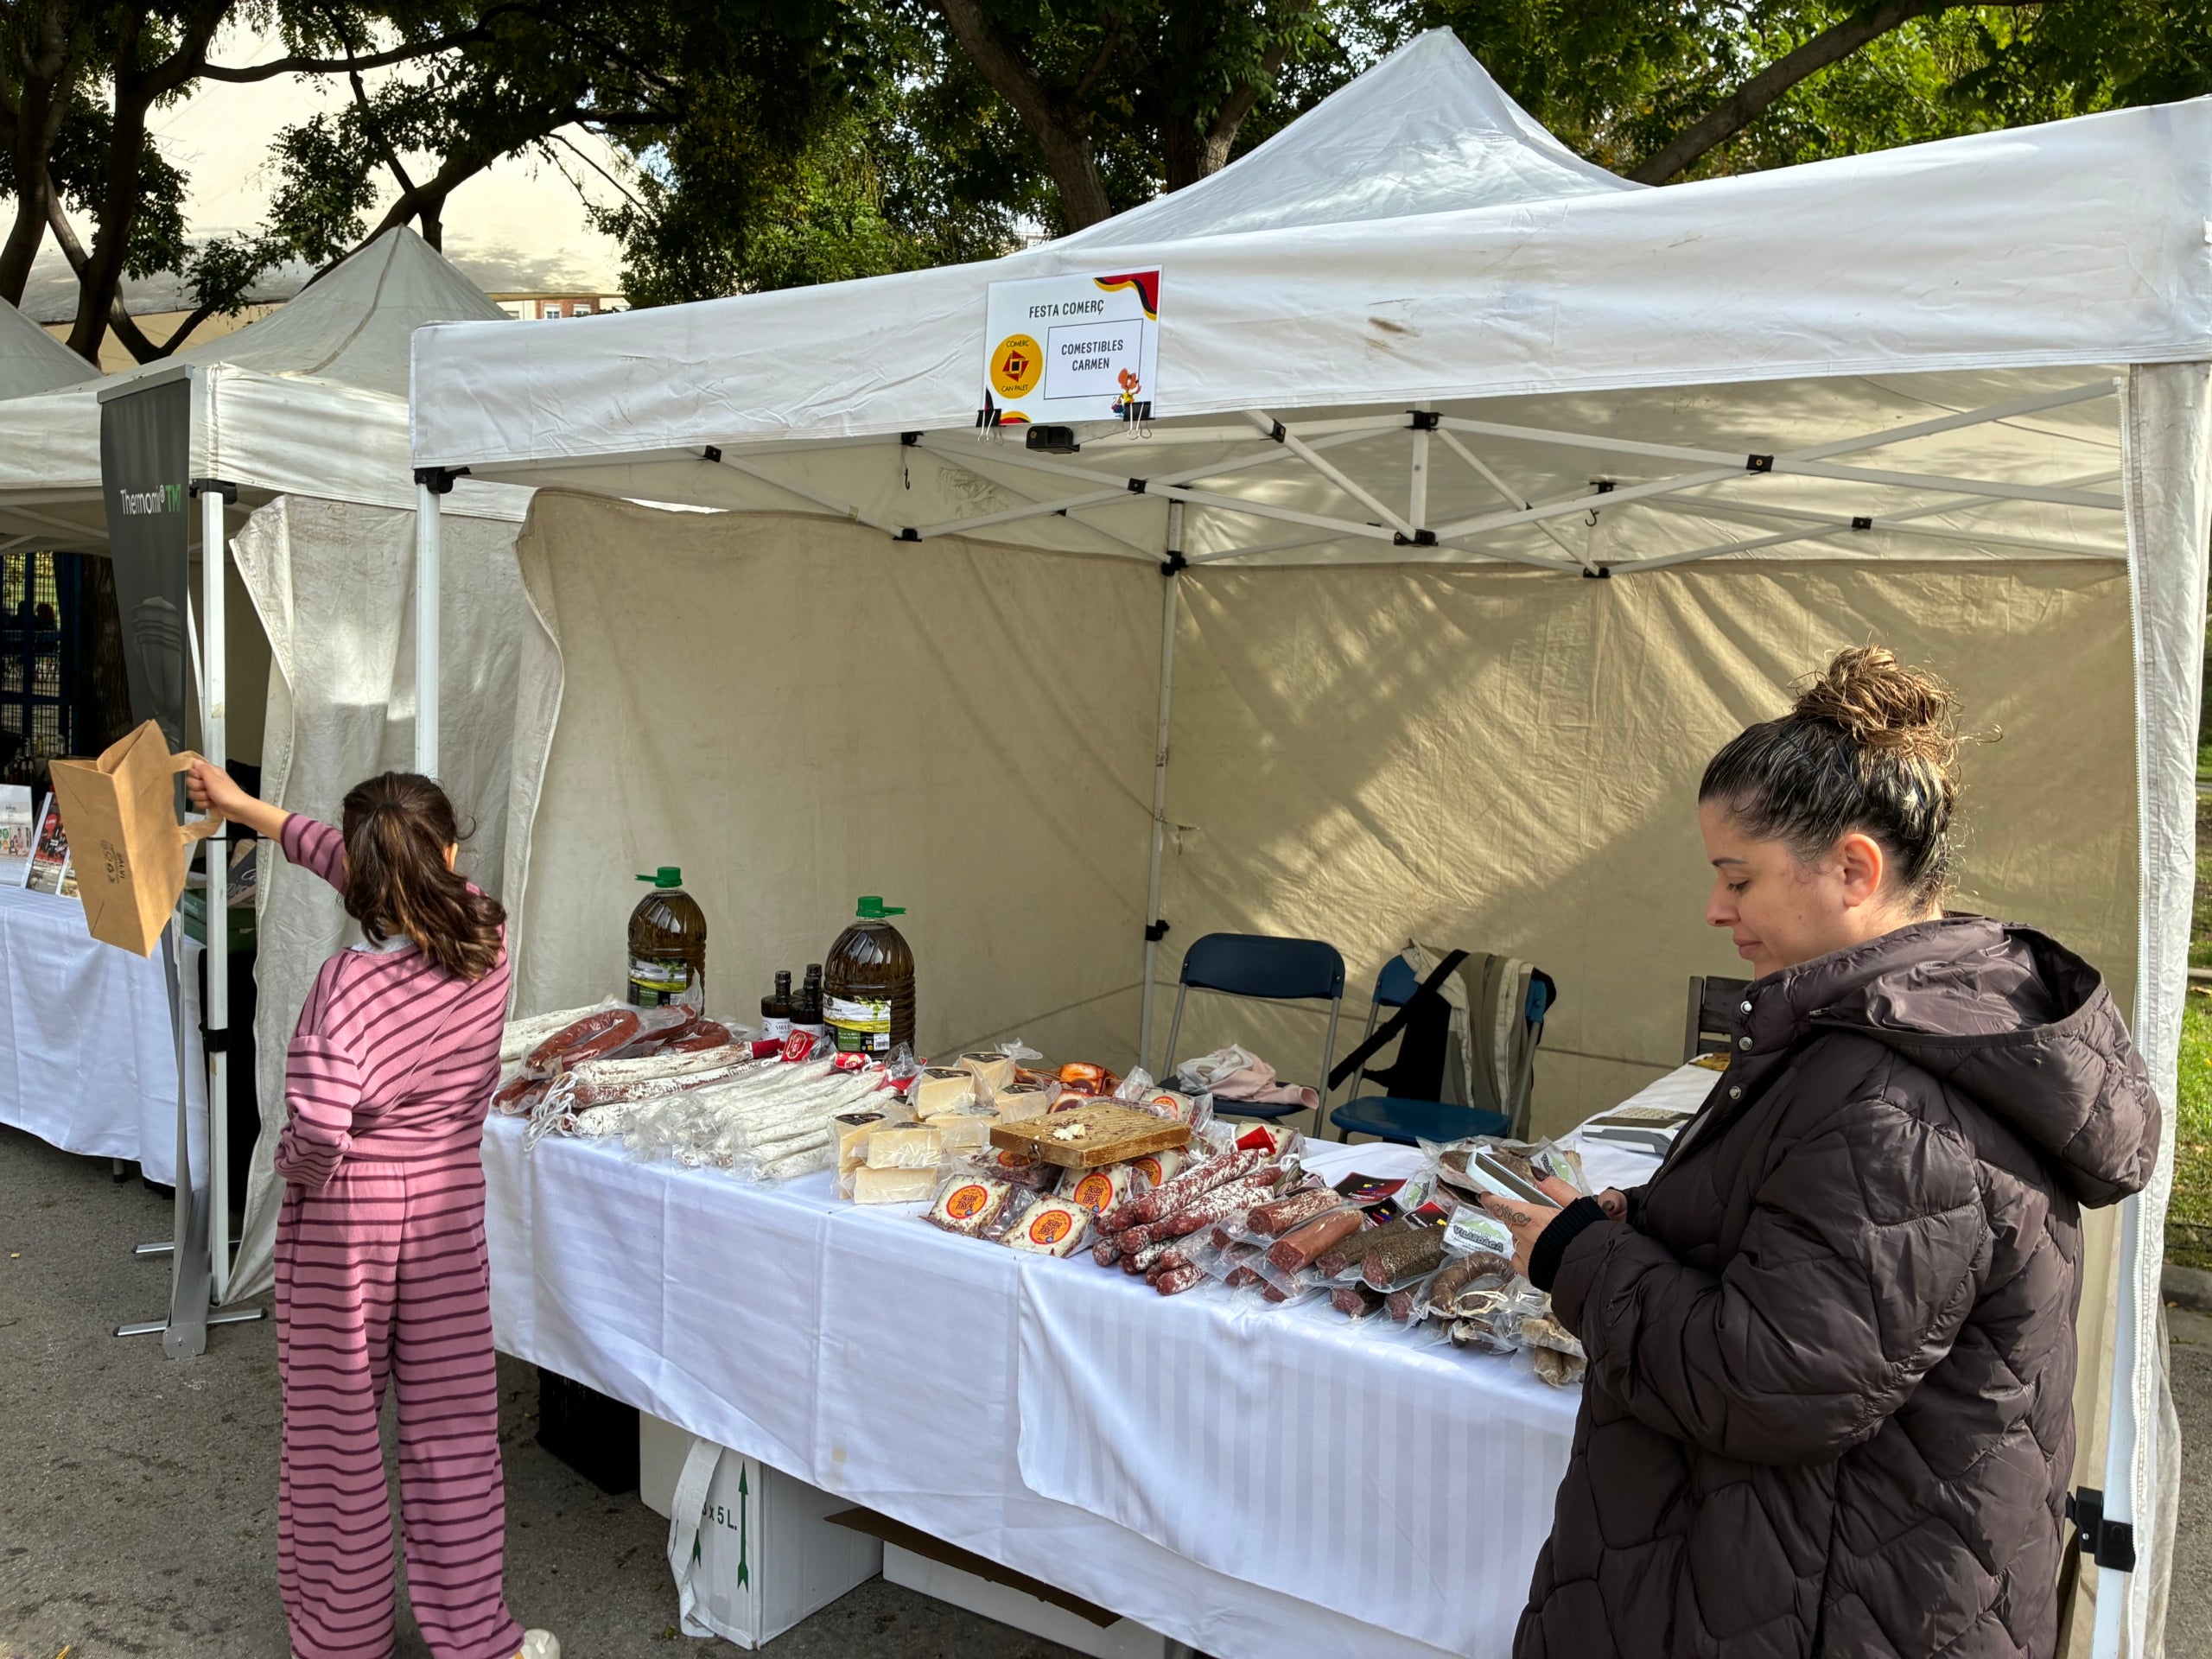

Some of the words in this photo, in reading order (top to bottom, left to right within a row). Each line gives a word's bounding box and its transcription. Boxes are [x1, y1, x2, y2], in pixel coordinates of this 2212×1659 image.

[1029, 304, 1059, 319] FESTA
[1063, 299, 1104, 315] COMERÇ
[1061, 340, 1123, 355] COMESTIBLES
[1072, 357, 1109, 372] CARMEN
